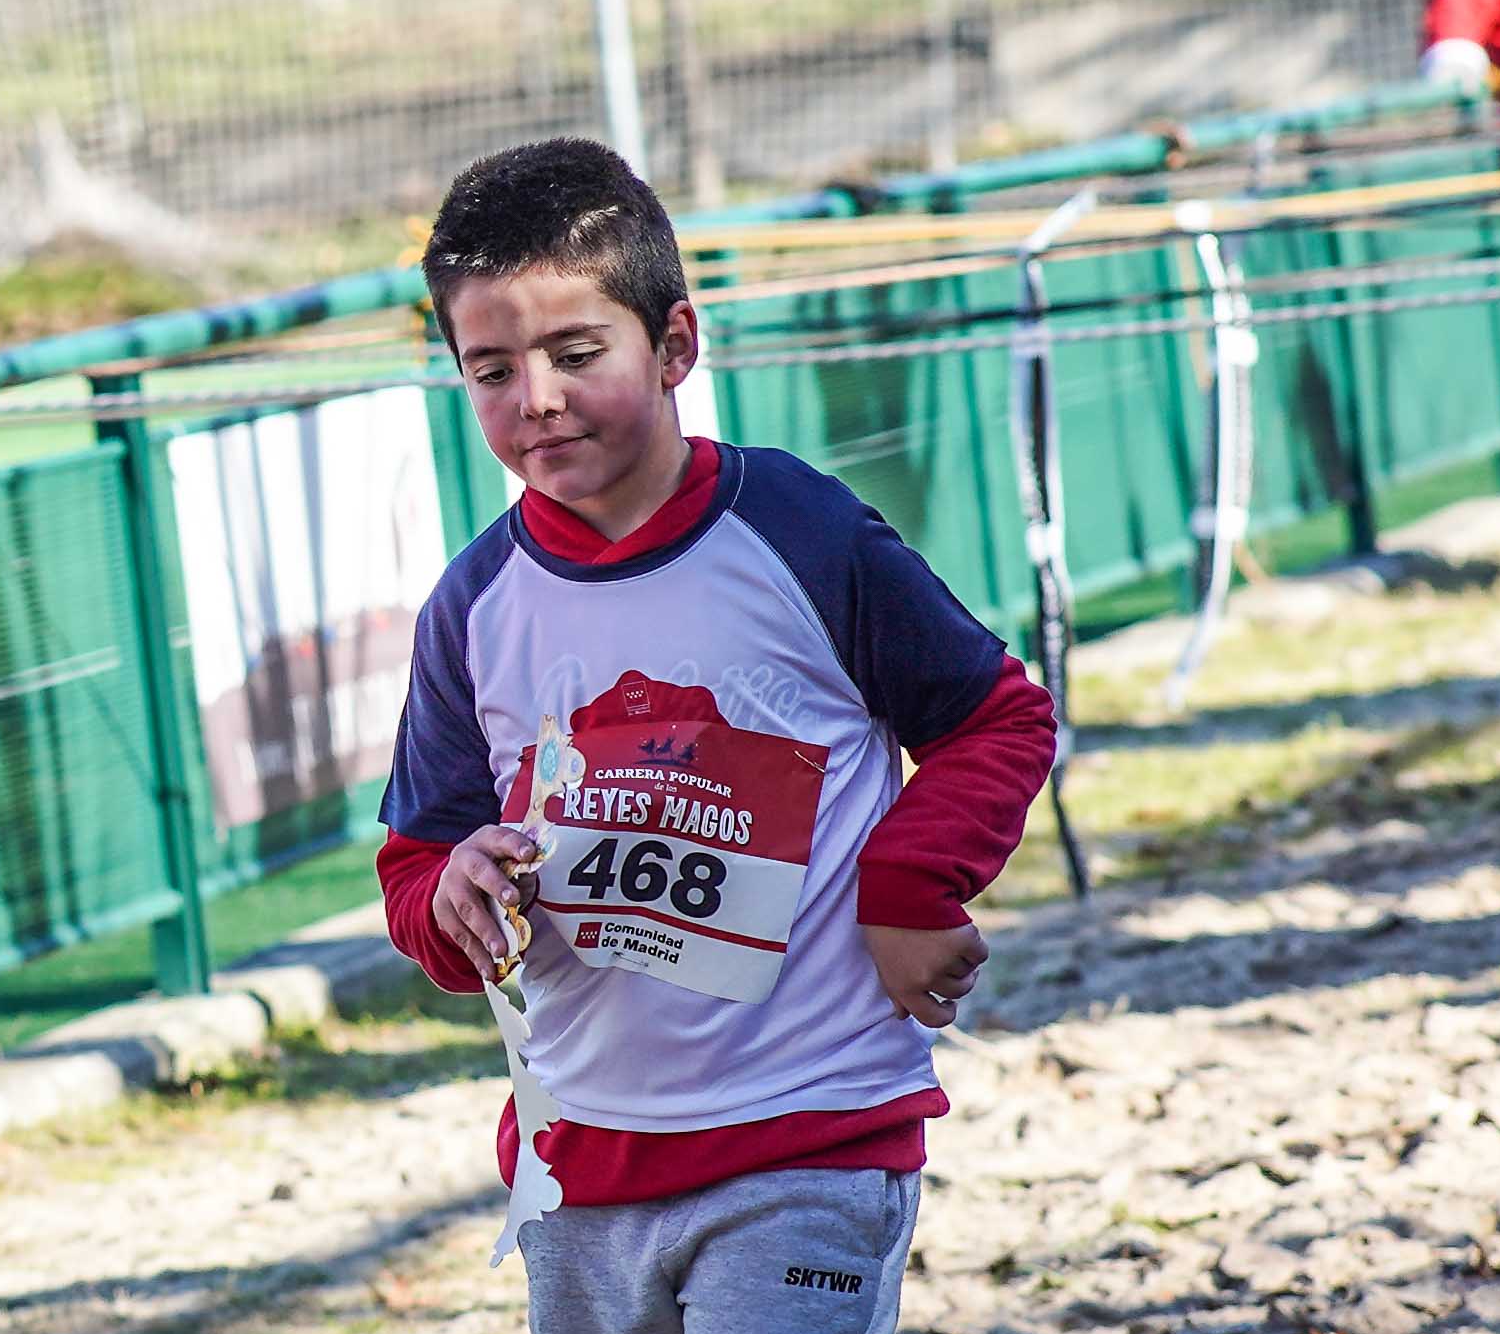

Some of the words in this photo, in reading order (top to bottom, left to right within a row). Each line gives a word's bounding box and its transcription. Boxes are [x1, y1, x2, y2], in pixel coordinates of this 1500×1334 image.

[594, 768, 665, 781] CARRERA
[669, 771, 732, 799] POPULAR
[563, 786, 652, 826] REYES
[658, 795, 753, 846] MAGOS
[567, 837, 727, 918] 468
[601, 936, 619, 948] de
[623, 938, 680, 964] Madrid
[604, 922, 684, 950] Comunidad
[784, 1266, 864, 1295] SKTWR
